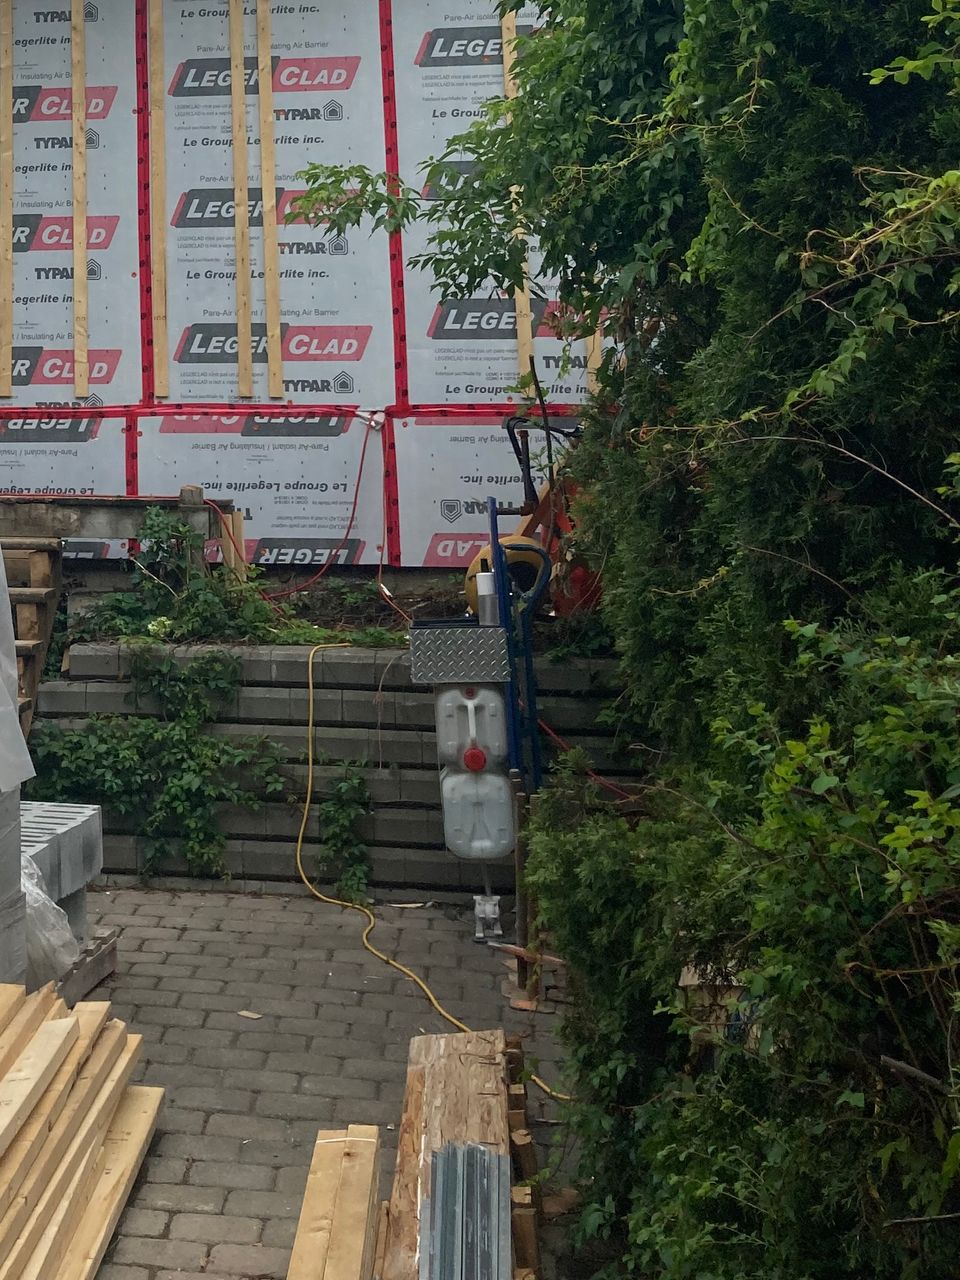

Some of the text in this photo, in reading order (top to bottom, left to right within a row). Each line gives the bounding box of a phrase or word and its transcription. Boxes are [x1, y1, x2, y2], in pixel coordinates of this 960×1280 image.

[34, 10, 72, 24] TYPA
[181, 3, 321, 19] Le Group Lerlite inc.
[444, 13, 501, 22] Pare-Air isolan
[11, 35, 58, 48] egerlite
[60, 34, 71, 45] in
[304, 40, 329, 49] Barrier
[430, 37, 505, 58] LEGE
[20, 71, 53, 83] Insulating
[54, 70, 64, 79] Air
[280, 66, 347, 86] CLAD
[41, 95, 105, 115] CLD
[273, 108, 322, 121] TYPAR
[432, 108, 488, 119] Le Group
[34, 137, 73, 150] TYPA
[183, 133, 325, 148] Le Group Lerlite inc.
[13, 162, 58, 174] egerlite
[61, 161, 74, 171] in
[200, 174, 229, 183] Pare-Air
[20, 199, 54, 210] Insulating
[54, 198, 65, 207] Air
[41, 223, 107, 245] CLD
[277, 241, 327, 255] TYPAR
[35, 267, 74, 280] TYPA
[187, 268, 330, 281] Le Group Lerlite inc.
[11, 293, 59, 306] egerlite
[62, 292, 74, 304] in
[202, 306, 340, 318] Pare-Air Air Barrier
[443, 308, 535, 330] LEGE
[21, 330, 55, 342] Insulating
[55, 330, 66, 340] Air
[288, 334, 359, 355] CLAD
[42, 357, 109, 379] CLD
[282, 379, 332, 393] TYPAR
[445, 384, 461, 394] Le
[218, 442, 229, 451] Air
[229, 441, 266, 452] Insulating
[477, 436, 489, 444] Air
[48, 448, 78, 457] Pare-Air
[191, 443, 217, 452] Barrier
[298, 443, 330, 452] Pare-Air
[200, 479, 348, 493] Le Groupe Legerlite inc.
[459, 475, 544, 486] Leerlite inc.
